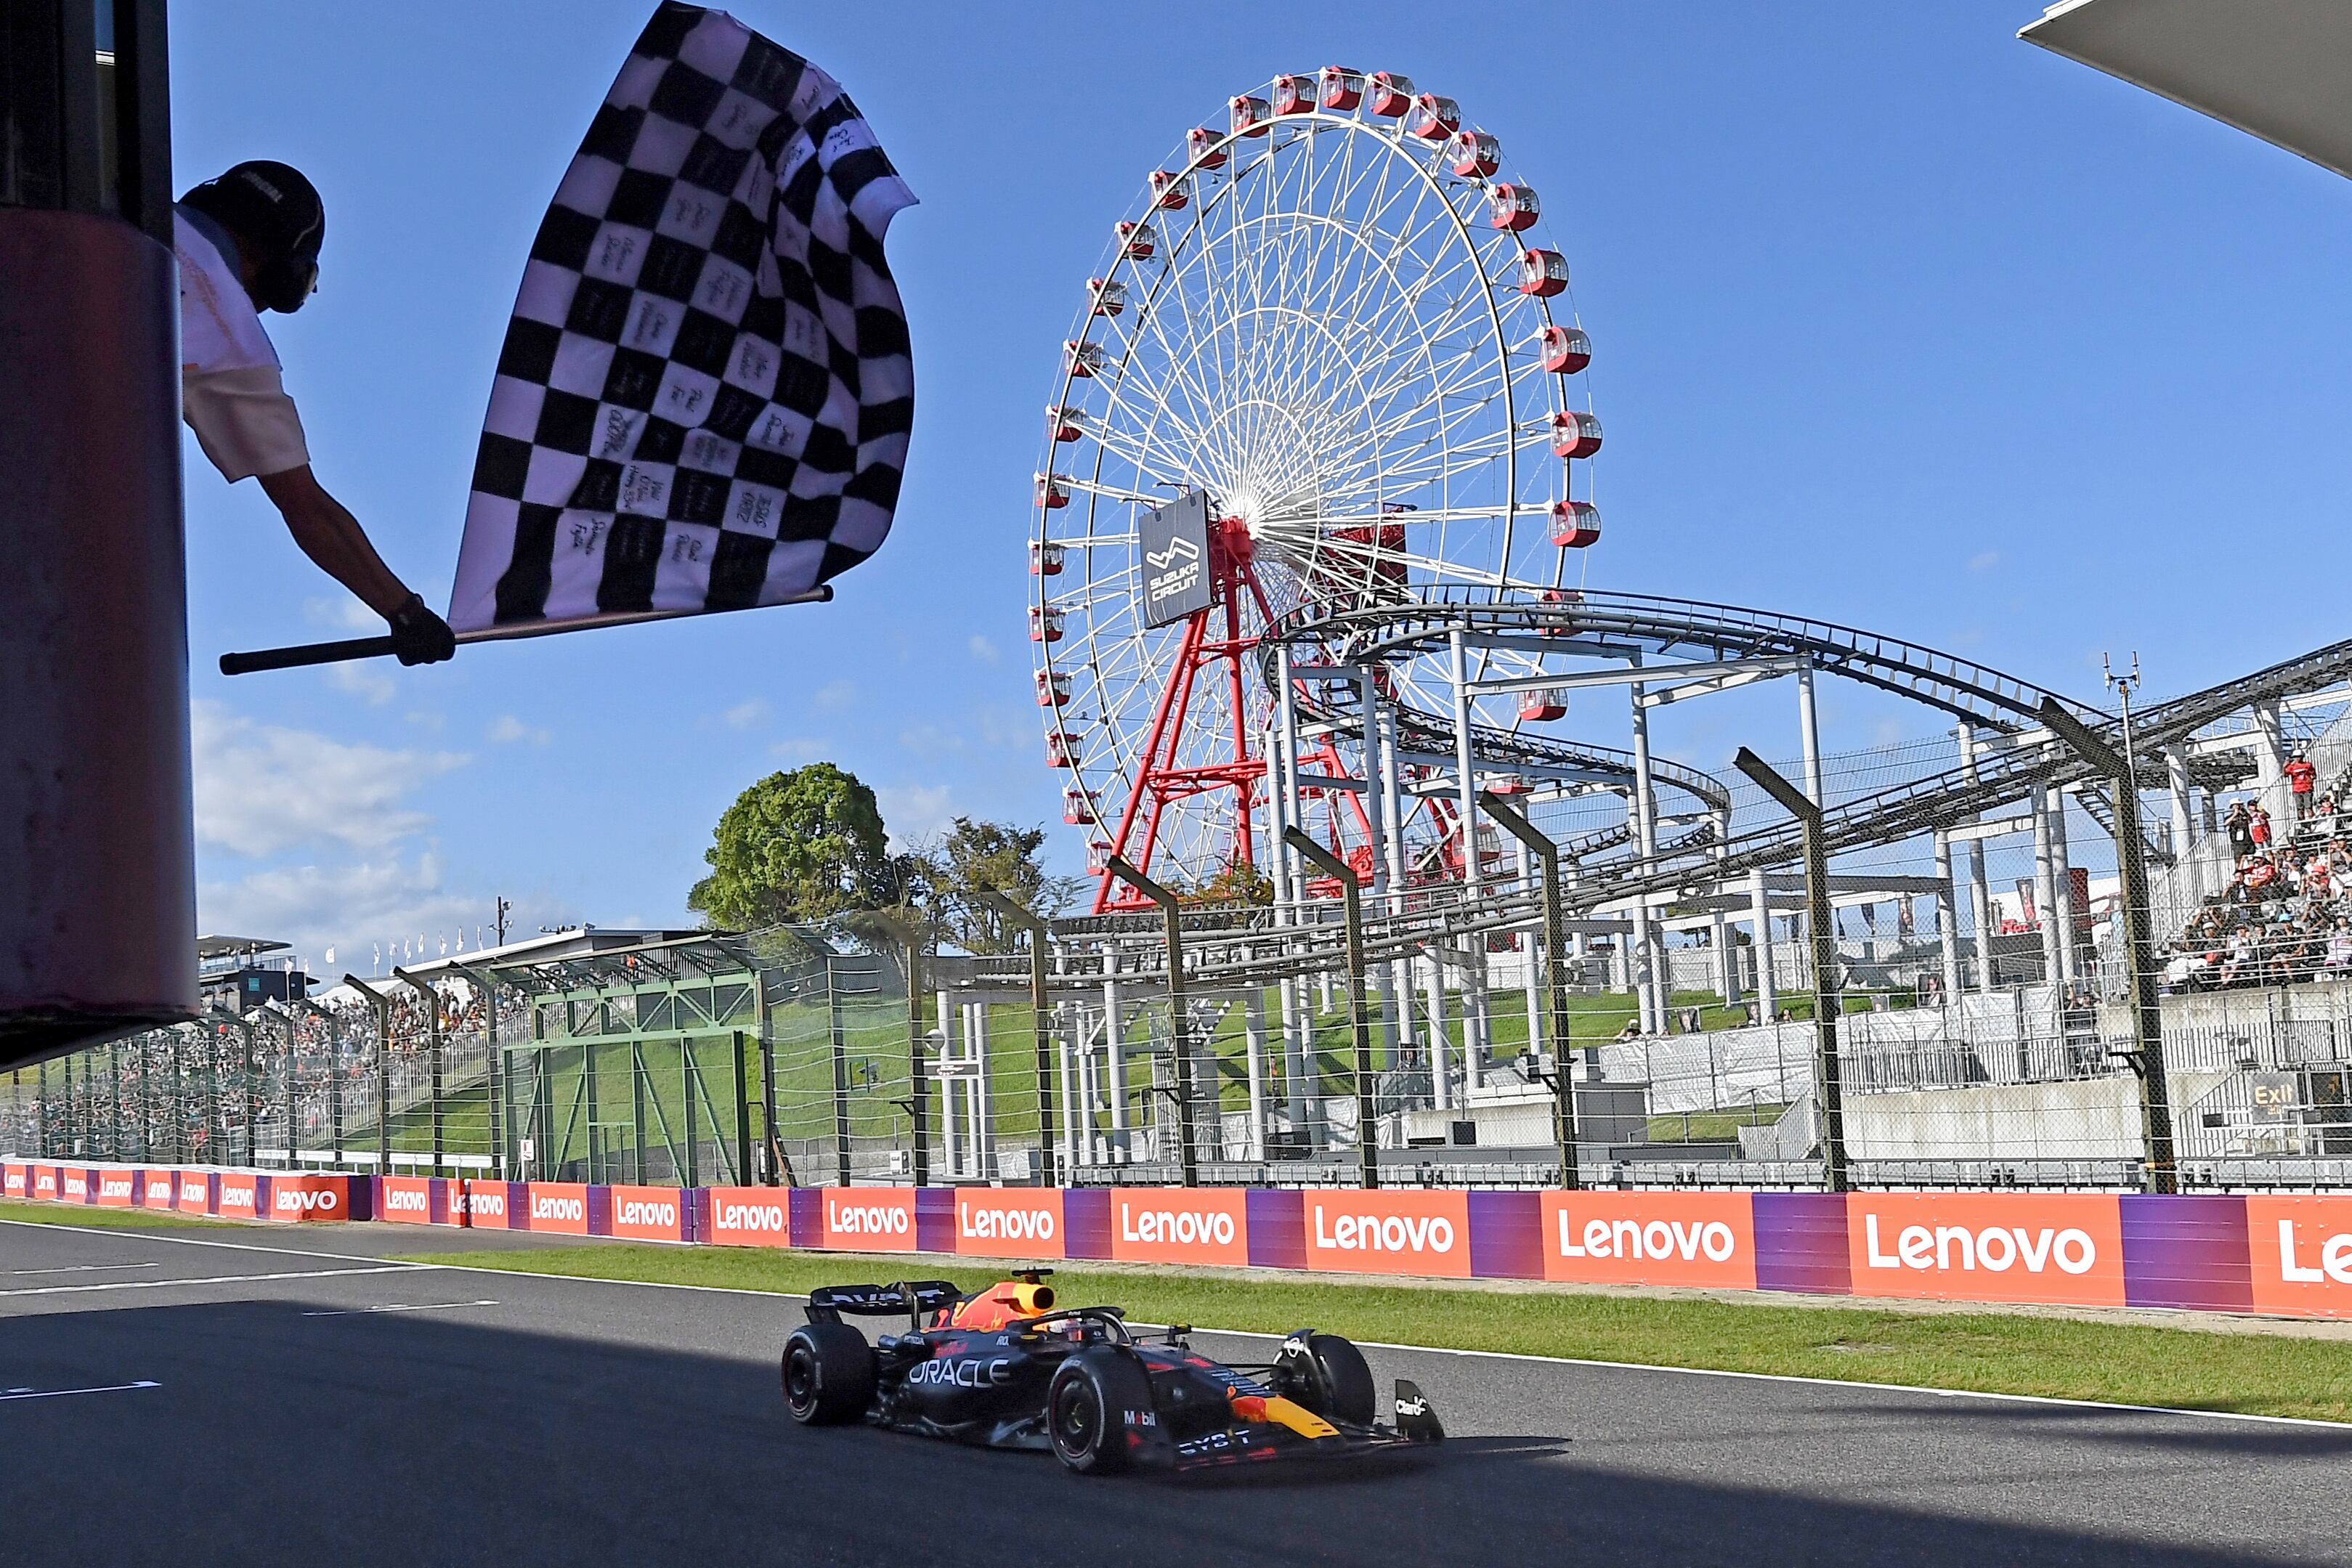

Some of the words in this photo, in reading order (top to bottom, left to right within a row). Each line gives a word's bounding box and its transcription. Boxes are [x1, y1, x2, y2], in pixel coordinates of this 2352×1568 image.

[1150, 561, 1199, 590] SUZUKA
[1152, 574, 1199, 602] CIRCUIT
[2255, 1084, 2293, 1104] Exit
[181, 1178, 206, 1203] Lnovo
[222, 1182, 254, 1207] Lenovo
[386, 1186, 426, 1211] Lenovo
[532, 1192, 583, 1222] Lenovo
[617, 1195, 676, 1227] Lenovo
[715, 1198, 783, 1232] Lenovo
[830, 1200, 909, 1235] Lenovo
[961, 1202, 1055, 1240] Lenovo
[1122, 1203, 1236, 1246] Lenovo
[1315, 1206, 1455, 1254] Lenovo
[1558, 1209, 1735, 1263] Lenovo
[1865, 1214, 2097, 1275] Lenovo
[909, 1359, 1010, 1389] ORACLE
[1124, 1410, 1156, 1426] Mobil
[1395, 1398, 1422, 1416] Claro
